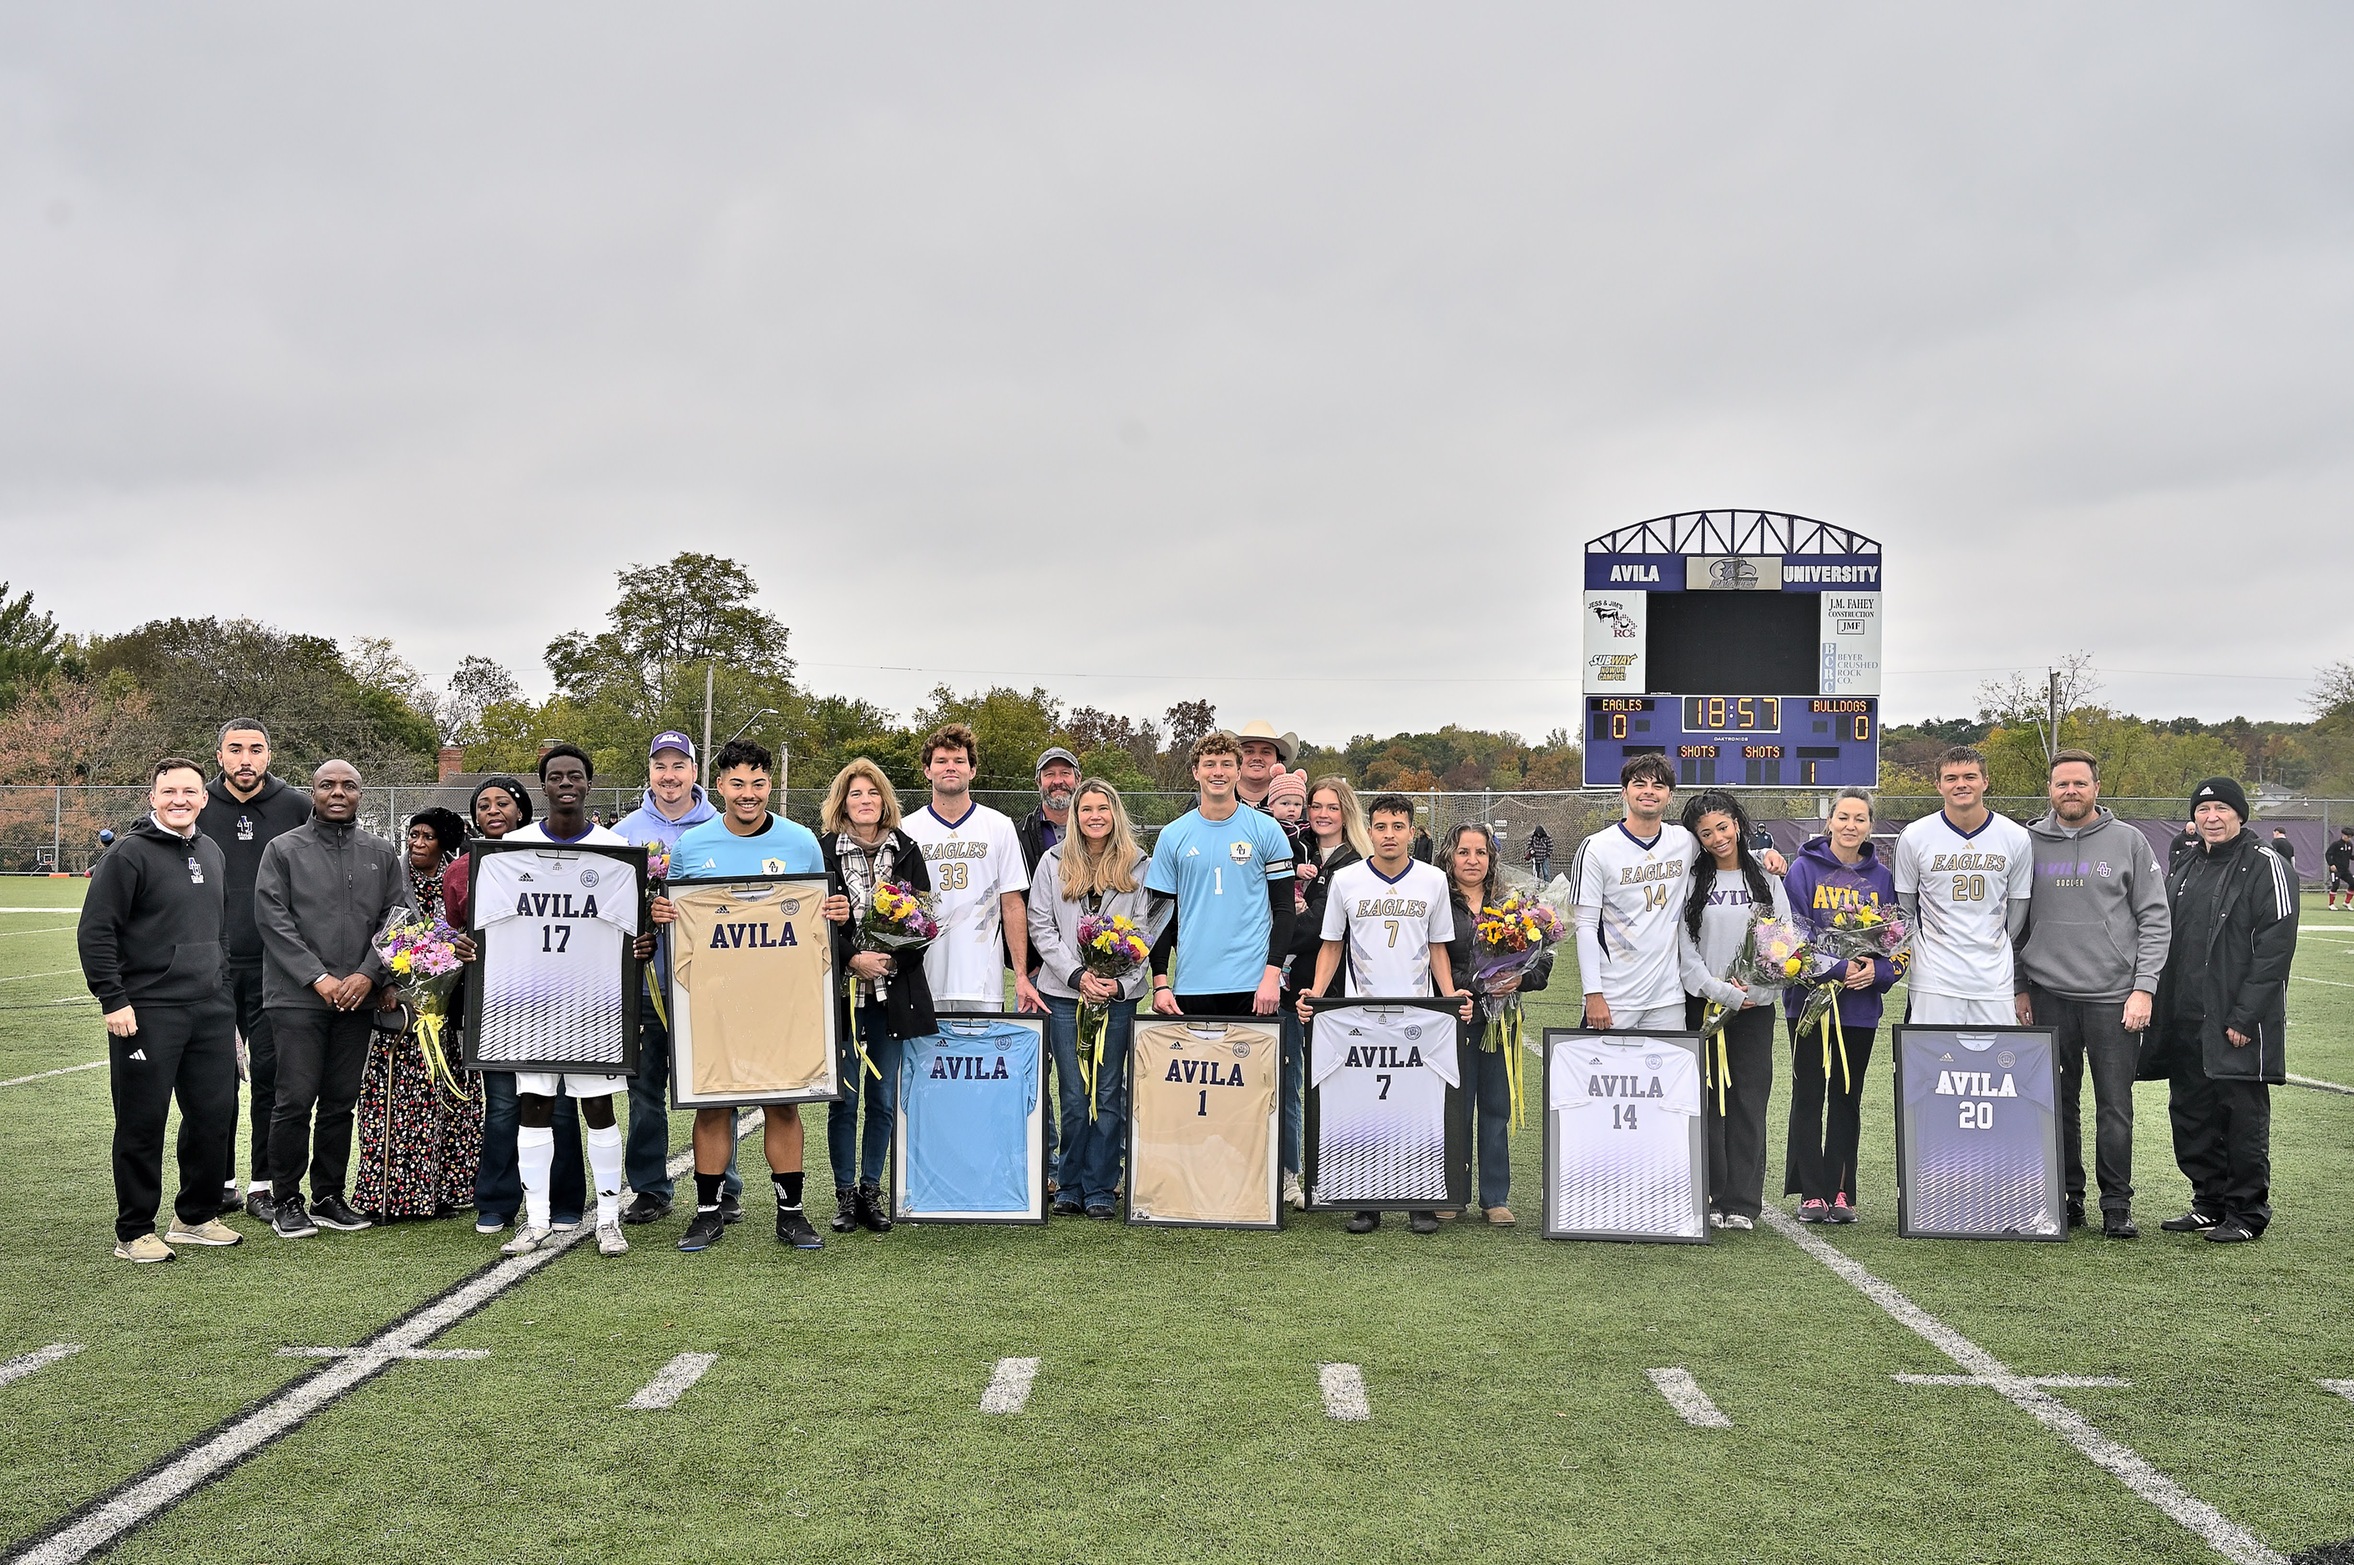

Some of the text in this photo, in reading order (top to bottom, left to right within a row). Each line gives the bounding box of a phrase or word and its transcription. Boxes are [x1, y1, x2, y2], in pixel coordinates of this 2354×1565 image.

[1610, 565, 1660, 582] AVILA
[1783, 565, 1878, 582] UNIVERSITY
[1588, 600, 1602, 609] JESS
[1829, 599, 1874, 611] J.M. FAHEY
[1841, 622, 1860, 631] JMF
[1589, 653, 1638, 666] SUBWAY
[1837, 661, 1878, 669] CRUSHED
[1837, 669, 1861, 677] ROCK
[1603, 700, 1642, 711] EAGLES
[1697, 698, 1778, 727] 18:57
[1813, 700, 1867, 712] BULLDOGS
[1613, 714, 1627, 739] 0
[1855, 715, 1869, 740] 0
[1680, 746, 1715, 757] SHOTS
[1745, 746, 1780, 758] SHOTS
[1810, 762, 1815, 784] 1
[921, 842, 988, 861] EAGLES
[1931, 854, 2006, 871] EAGLES
[939, 862, 968, 891] 33
[1214, 867, 1223, 895] 1
[1620, 860, 1683, 885] EAGLES
[1643, 884, 1668, 912] 14
[1952, 874, 1985, 901] 20
[516, 892, 598, 918] AVILA
[1356, 899, 1427, 918] EAGLES
[542, 924, 571, 953] 17
[709, 921, 798, 949] AVILA
[1384, 920, 1399, 948] 7
[930, 1056, 1009, 1080] AVILA
[1344, 1046, 1423, 1068] AVILA
[1165, 1059, 1245, 1087] AVILA
[1935, 1070, 2018, 1098] AVILA
[1376, 1074, 1391, 1100] 7
[1588, 1075, 1664, 1098] AVILA
[1198, 1089, 1207, 1116] 1
[1612, 1104, 1637, 1130] 14
[1959, 1101, 1993, 1129] 20
